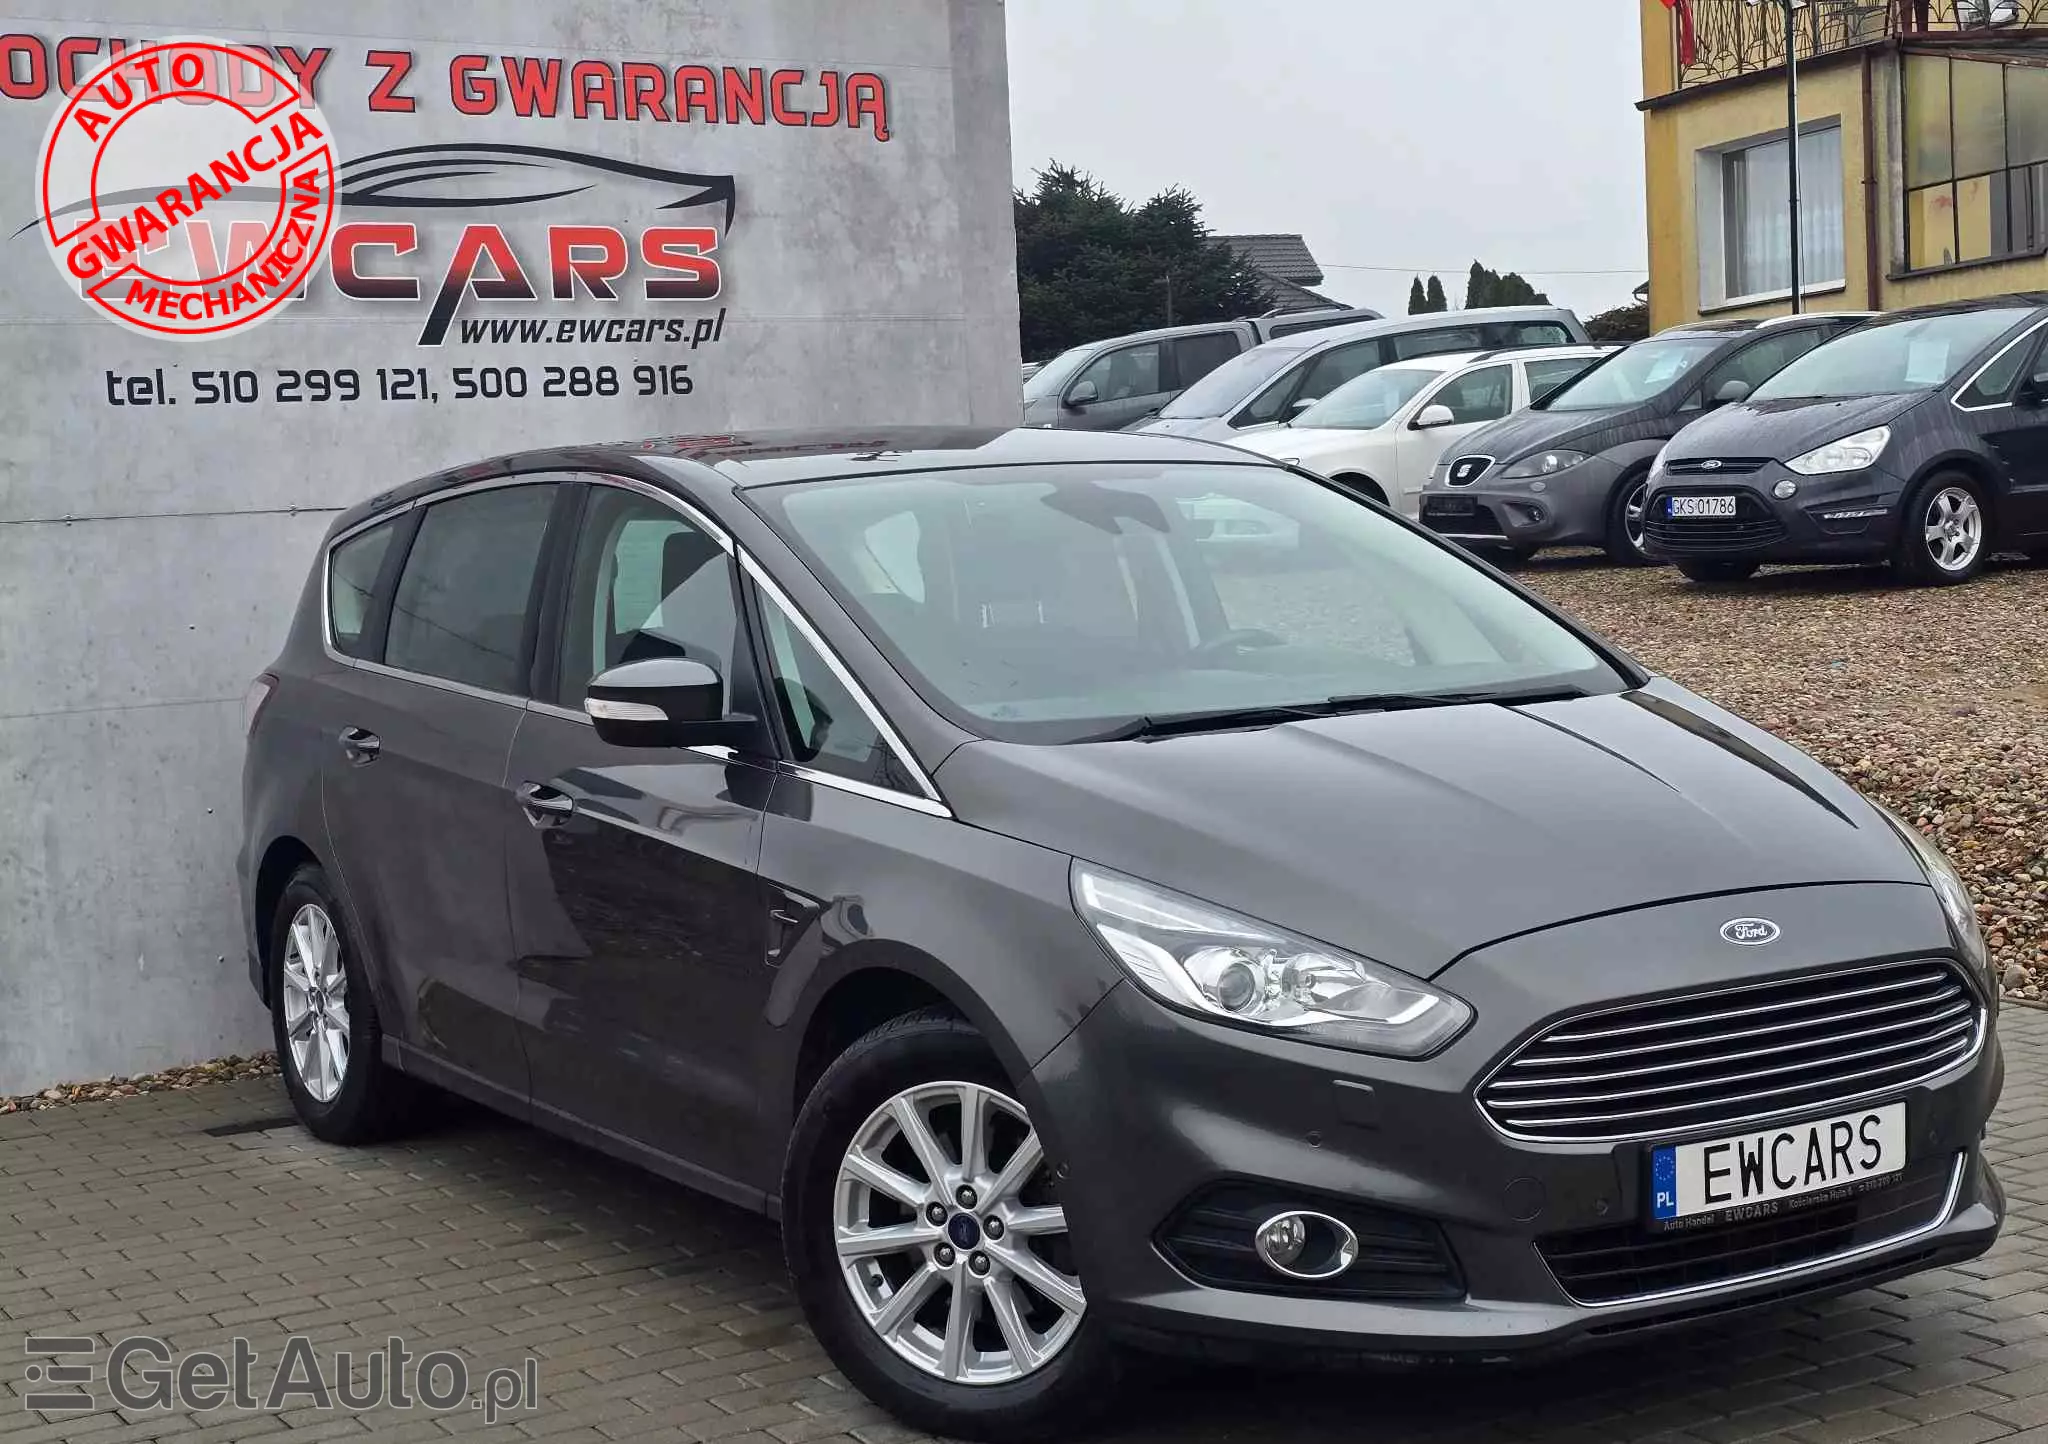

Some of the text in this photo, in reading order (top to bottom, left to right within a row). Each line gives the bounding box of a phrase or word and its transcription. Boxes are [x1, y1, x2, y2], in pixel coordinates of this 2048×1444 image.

[365, 49, 417, 113] Z
[449, 54, 890, 142] GWARANCJĄ
[461, 308, 726, 349] www.ewcars.pl
[106, 364, 694, 406] tel. 510 299 121, 500 288 916
[1673, 498, 1735, 514] GKS 01786
[1734, 923, 1768, 940] Ford
[1704, 1114, 1881, 1205] EWCARS
[1656, 1191, 1675, 1208] PL
[1725, 1201, 1779, 1221] EWCARS
